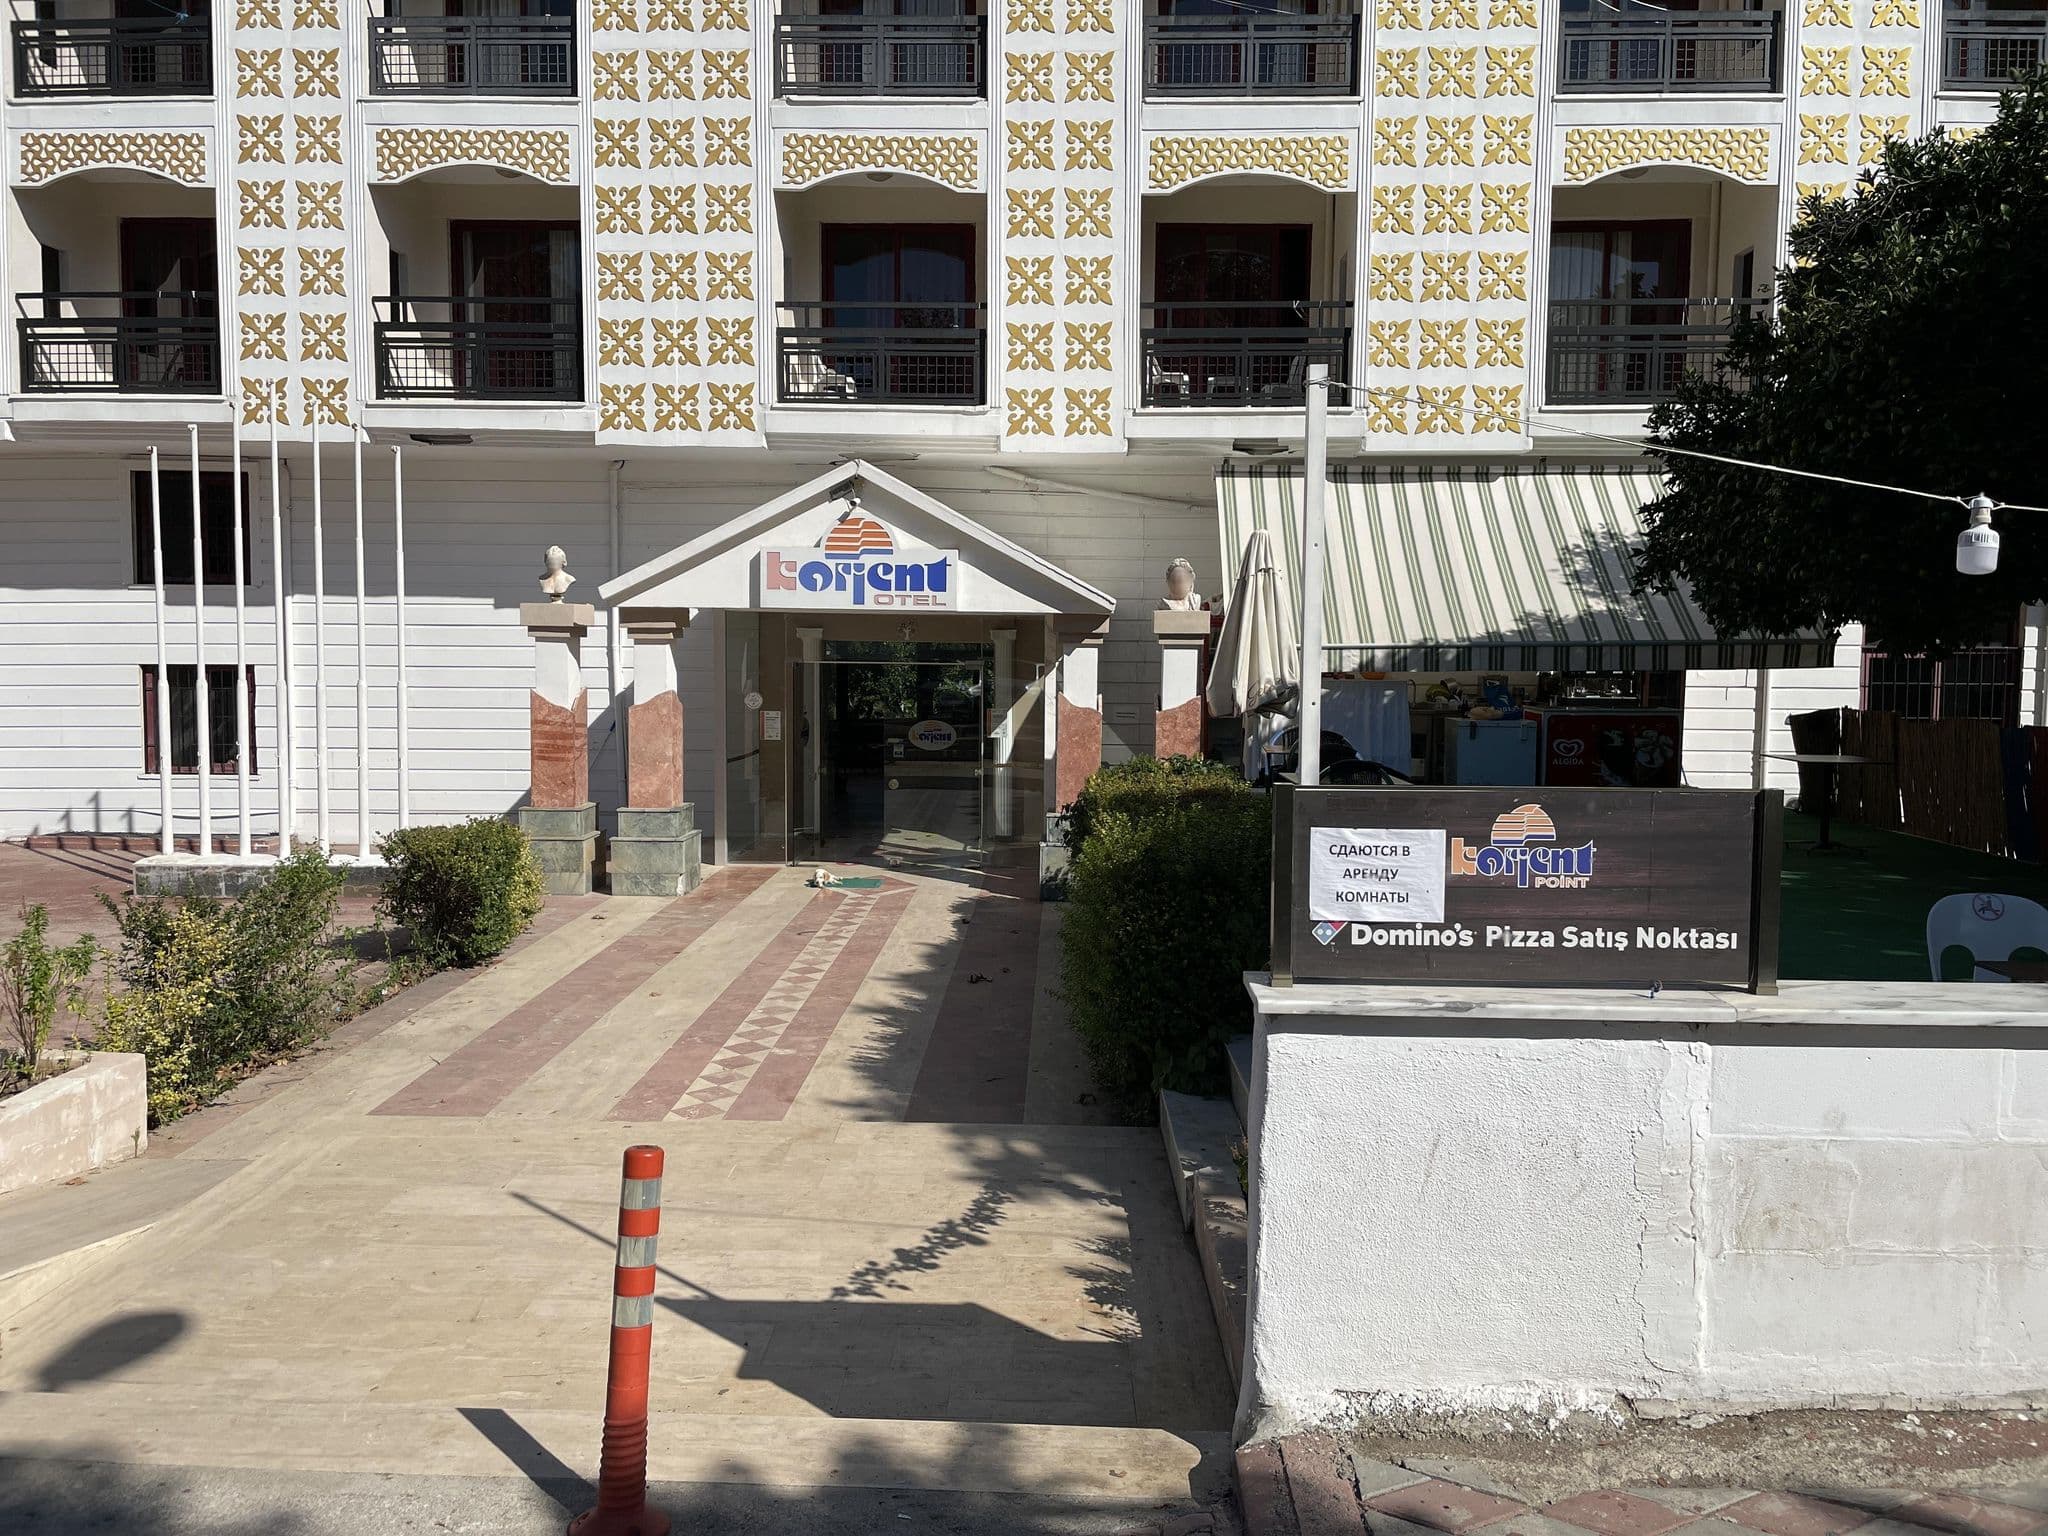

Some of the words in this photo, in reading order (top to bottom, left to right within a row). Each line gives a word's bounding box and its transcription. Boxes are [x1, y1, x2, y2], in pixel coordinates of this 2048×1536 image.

[873, 593, 947, 607] OTEL
[1329, 844, 1398, 858] СДАЮТСЯ
[1402, 845, 1411, 857] В
[1342, 867, 1400, 881] АРЕНДУ
[1335, 890, 1409, 903] КОМНАТЫ
[1485, 925, 1555, 948] Pizza
[1561, 926, 1629, 951] Satış
[1636, 927, 1738, 950] Noktası
